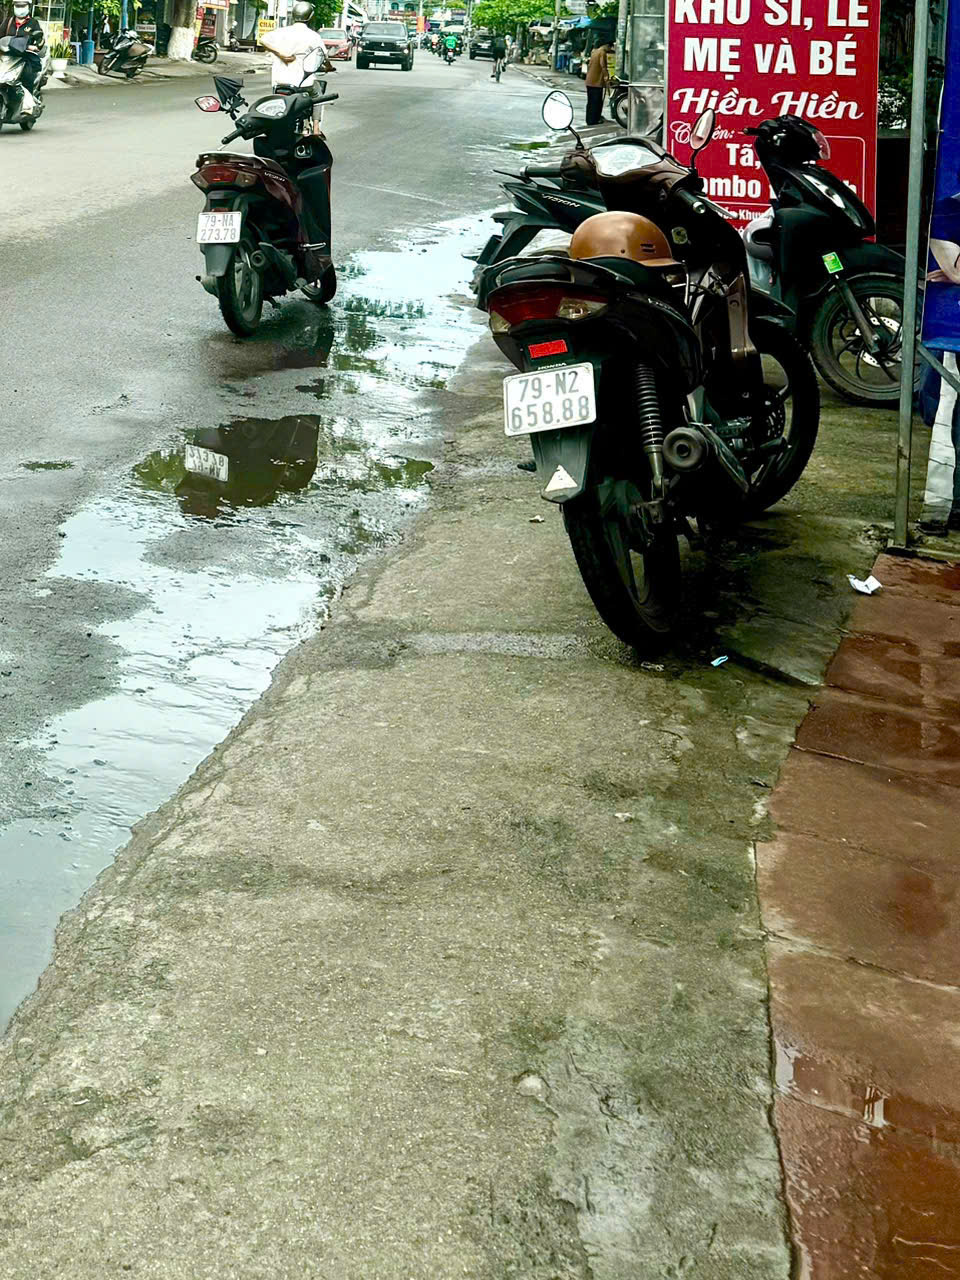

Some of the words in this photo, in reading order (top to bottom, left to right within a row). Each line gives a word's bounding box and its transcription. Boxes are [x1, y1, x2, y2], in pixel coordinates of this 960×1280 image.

[683, 37, 741, 80] MẸ
[754, 37, 796, 75] VÀ
[809, 33, 857, 76] BÉ
[672, 88, 764, 116] Hiền
[771, 91, 864, 120] Hiền
[542, 192, 580, 209] VISION
[200, 228, 237, 241] 273.78
[205, 214, 234, 227] 79-NA
[518, 370, 580, 402] 79-N2
[511, 394, 590, 430] 658.88
